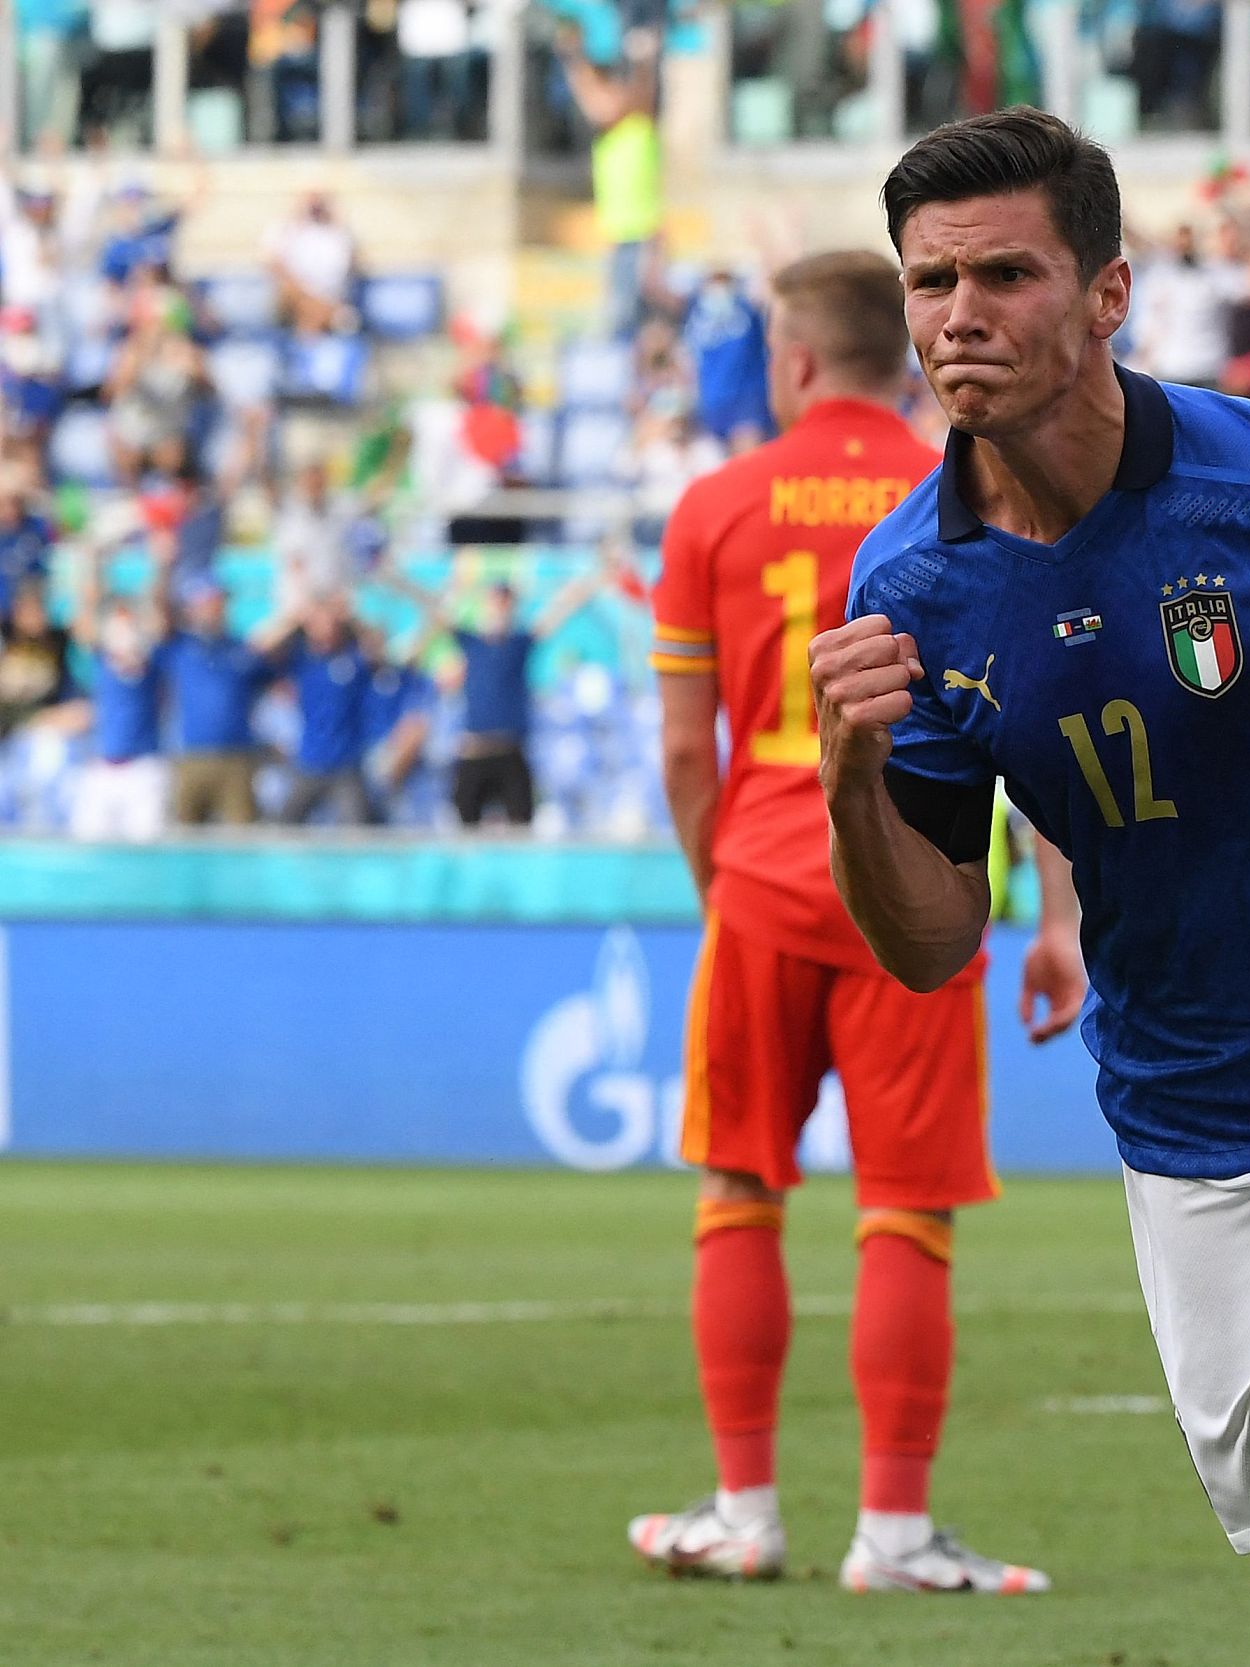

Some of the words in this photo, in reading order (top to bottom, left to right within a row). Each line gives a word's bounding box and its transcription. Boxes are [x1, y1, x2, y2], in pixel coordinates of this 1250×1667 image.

[769, 475, 912, 527] MORRE
[1168, 599, 1227, 623] ITALIA
[1057, 699, 1179, 828] 12
